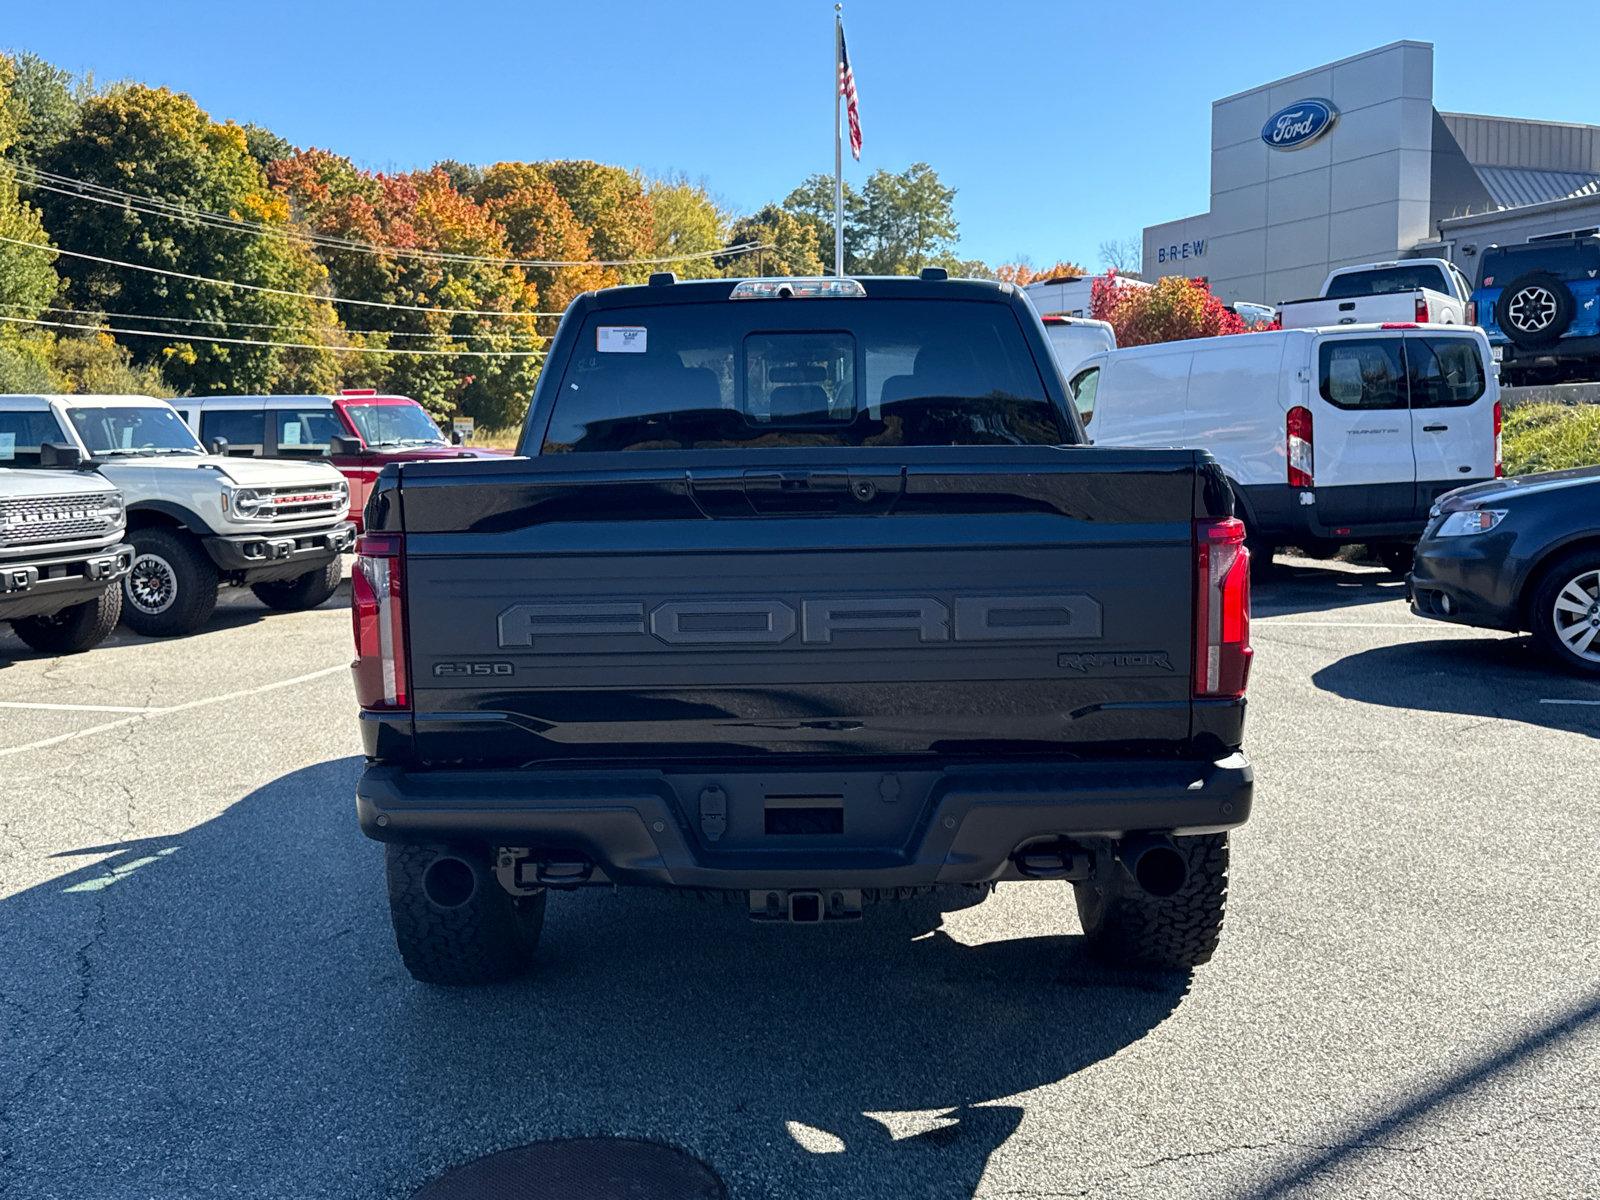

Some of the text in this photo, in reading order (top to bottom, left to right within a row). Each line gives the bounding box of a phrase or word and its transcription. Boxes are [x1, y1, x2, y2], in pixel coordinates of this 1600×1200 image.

[1273, 110, 1314, 142] Ford
[1158, 239, 1205, 263] BREW
[9, 509, 98, 524] BRONCO
[497, 592, 1103, 649] FORD
[434, 662, 514, 676] F-150
[1058, 651, 1175, 672] RAPTOR
